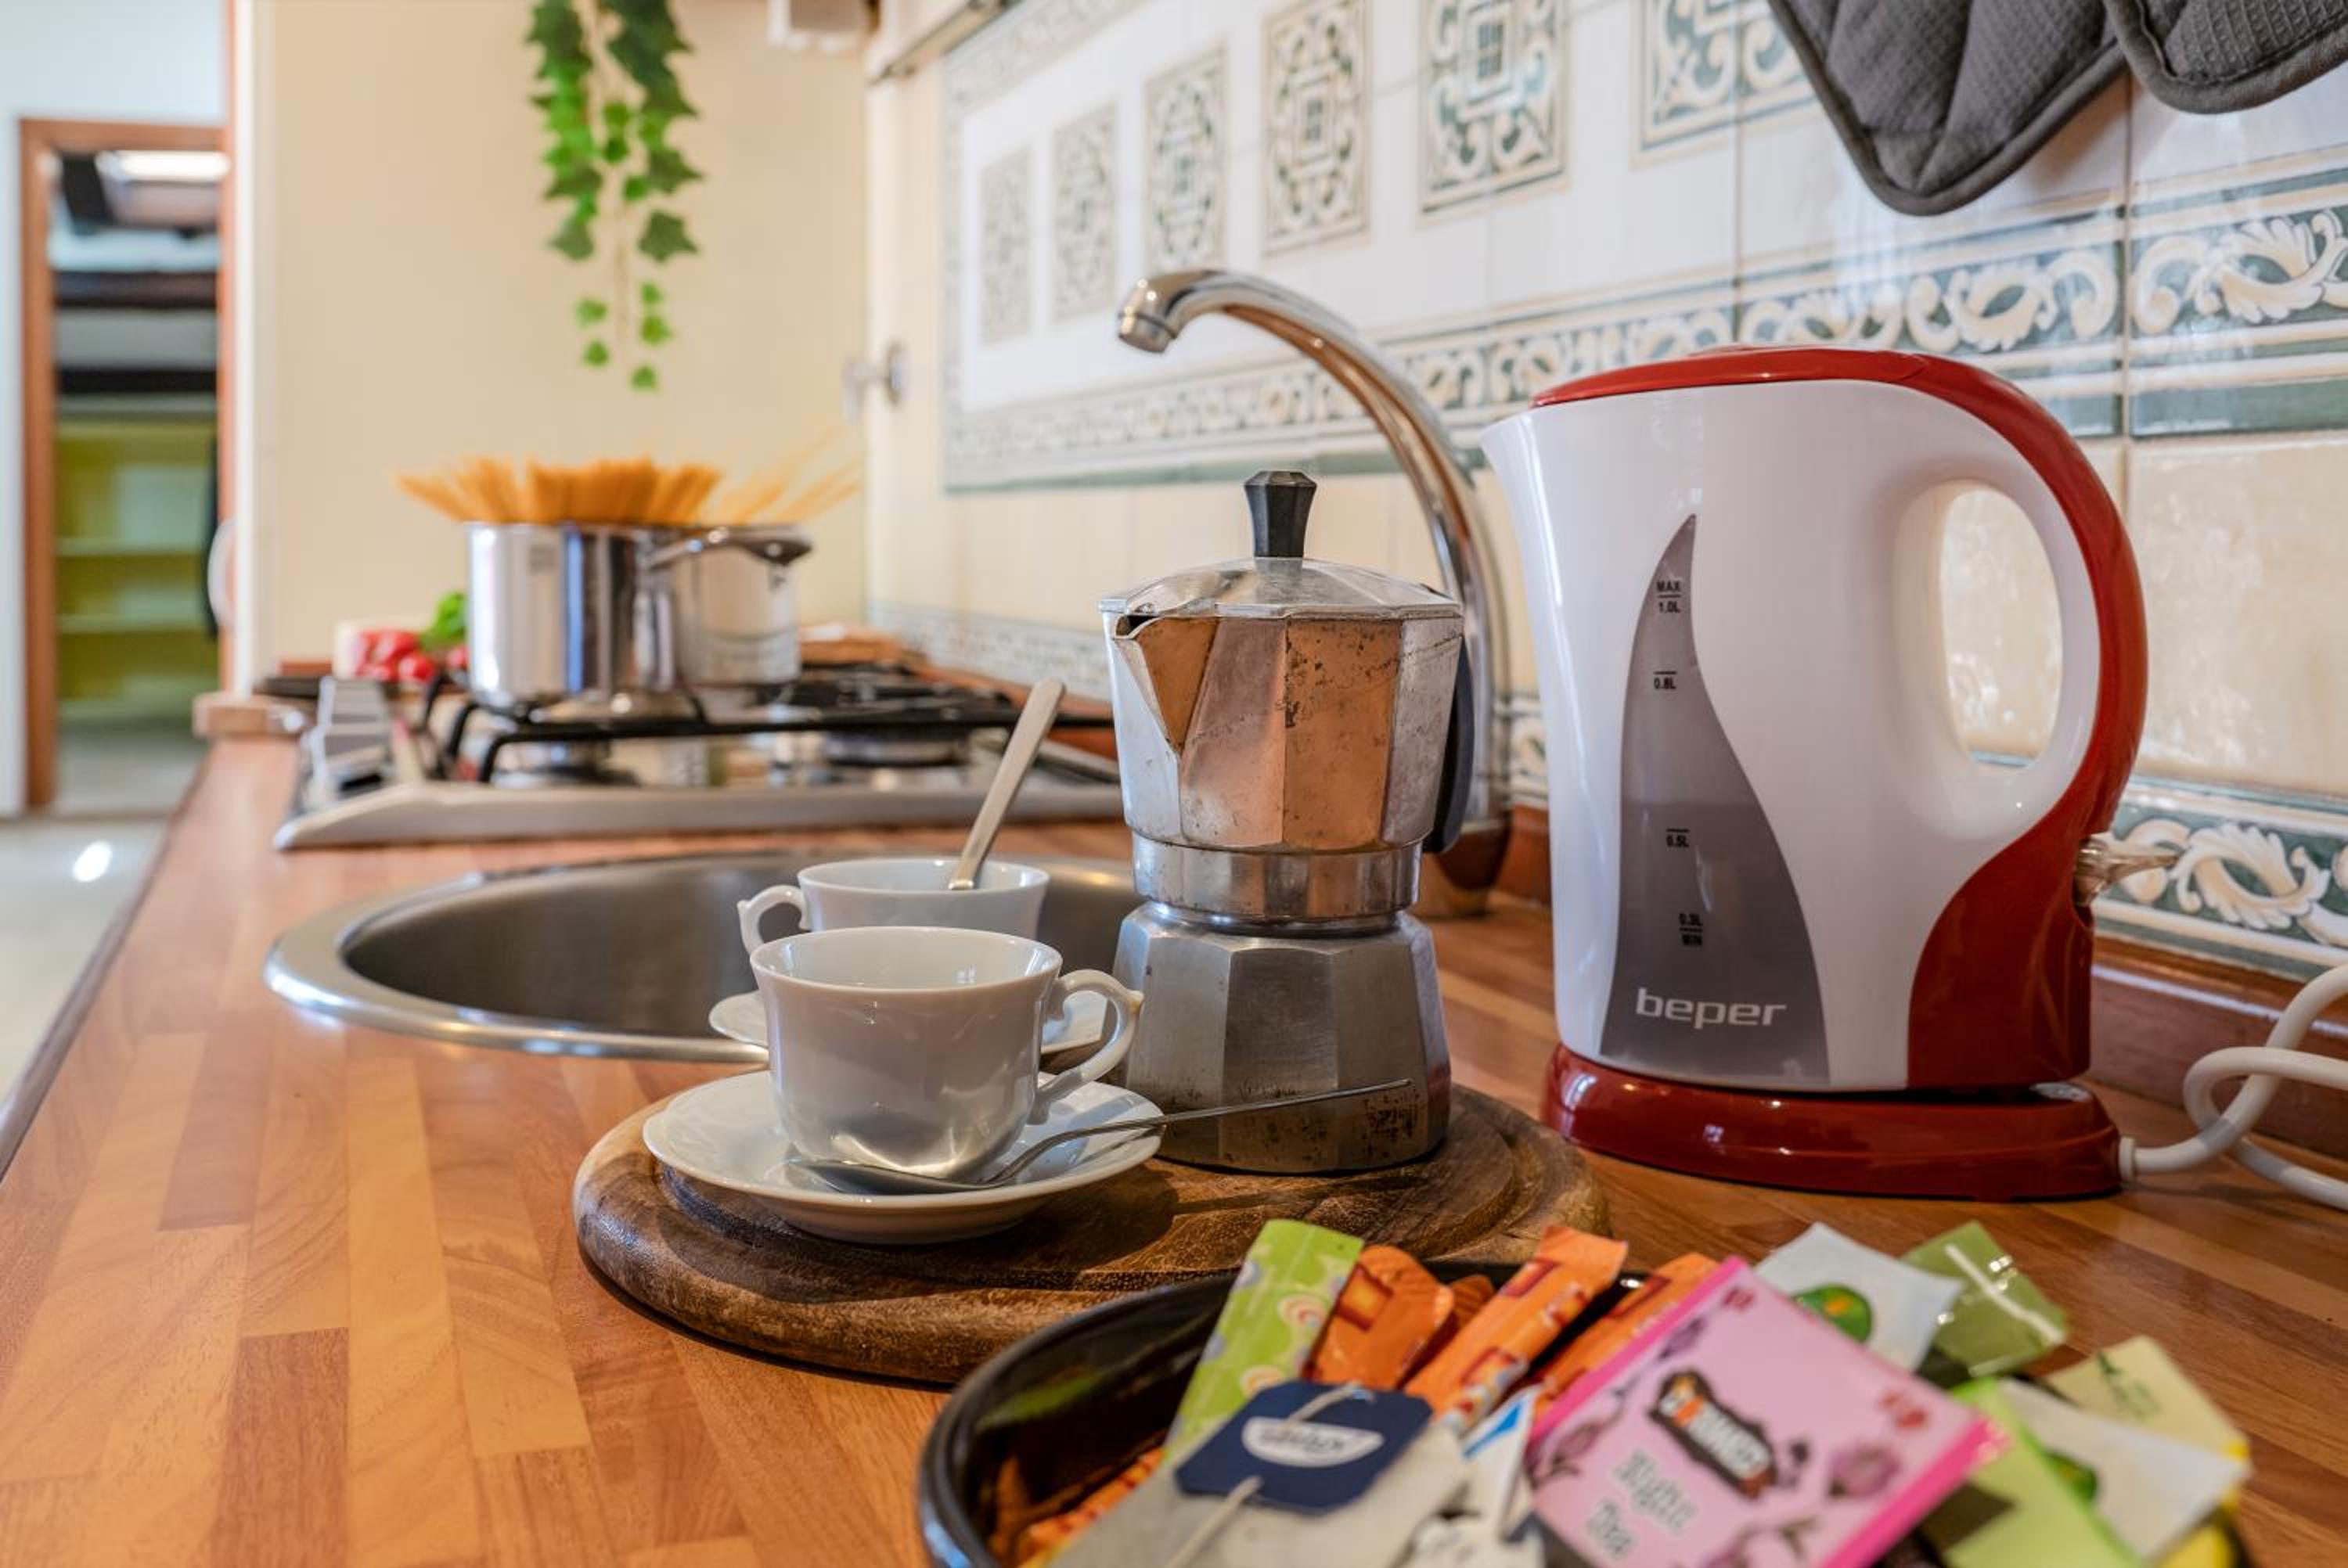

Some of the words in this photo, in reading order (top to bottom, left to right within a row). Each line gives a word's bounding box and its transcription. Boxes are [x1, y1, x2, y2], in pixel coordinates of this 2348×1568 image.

[1657, 581, 1680, 592] MAX
[1653, 677, 1676, 689] 0.8L
[1636, 987, 1787, 1030] beper
